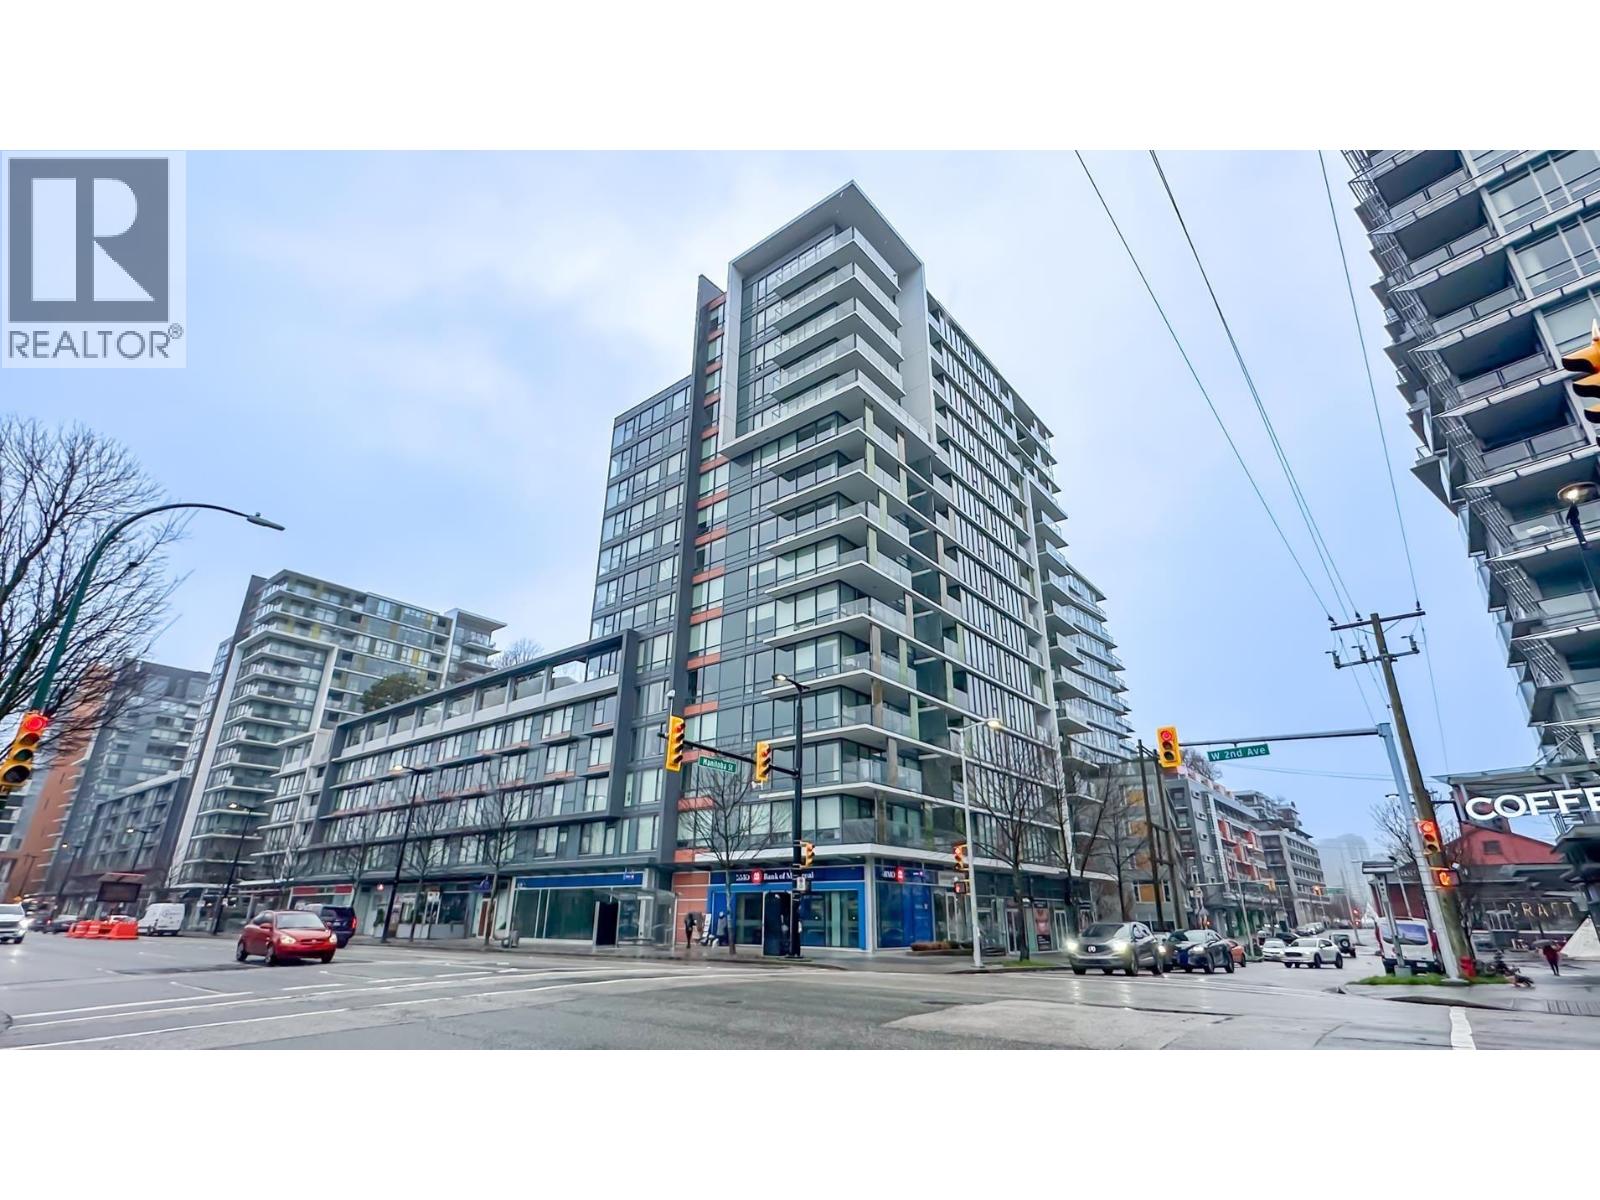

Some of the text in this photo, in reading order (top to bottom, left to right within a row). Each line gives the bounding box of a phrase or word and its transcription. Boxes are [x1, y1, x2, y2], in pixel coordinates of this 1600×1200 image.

[1211, 747, 1266, 760] W 2nd Ave
